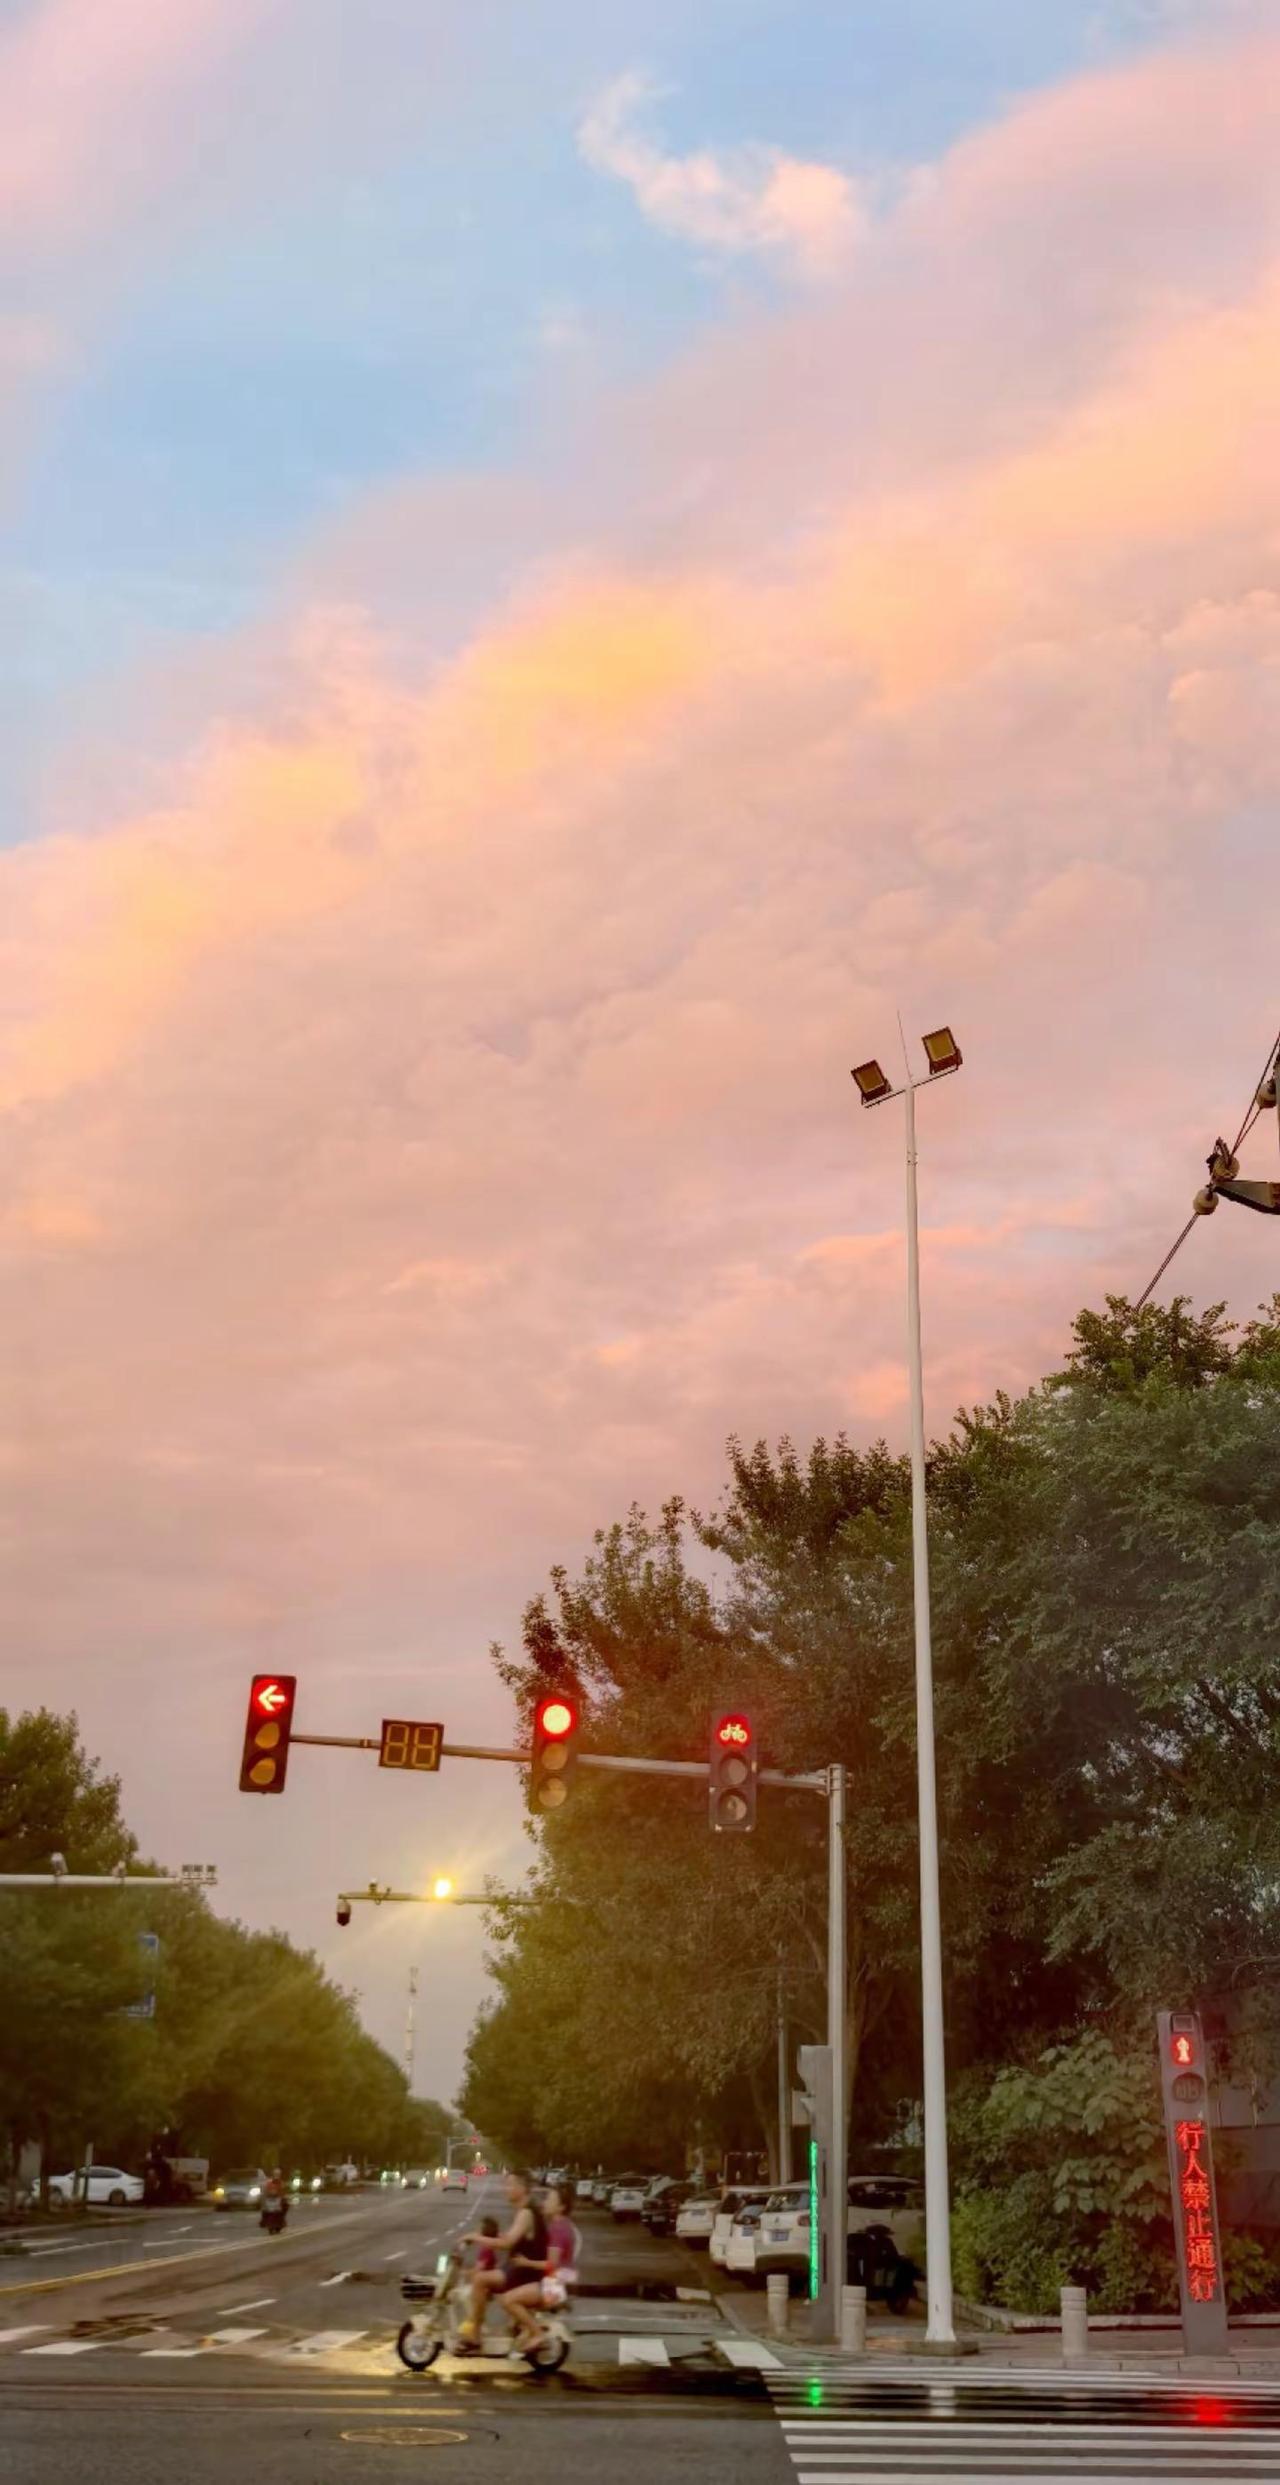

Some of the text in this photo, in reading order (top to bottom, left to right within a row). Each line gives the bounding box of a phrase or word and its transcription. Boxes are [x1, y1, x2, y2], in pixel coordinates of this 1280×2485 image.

[1176, 2121, 1217, 2301] 行人禁止通行
